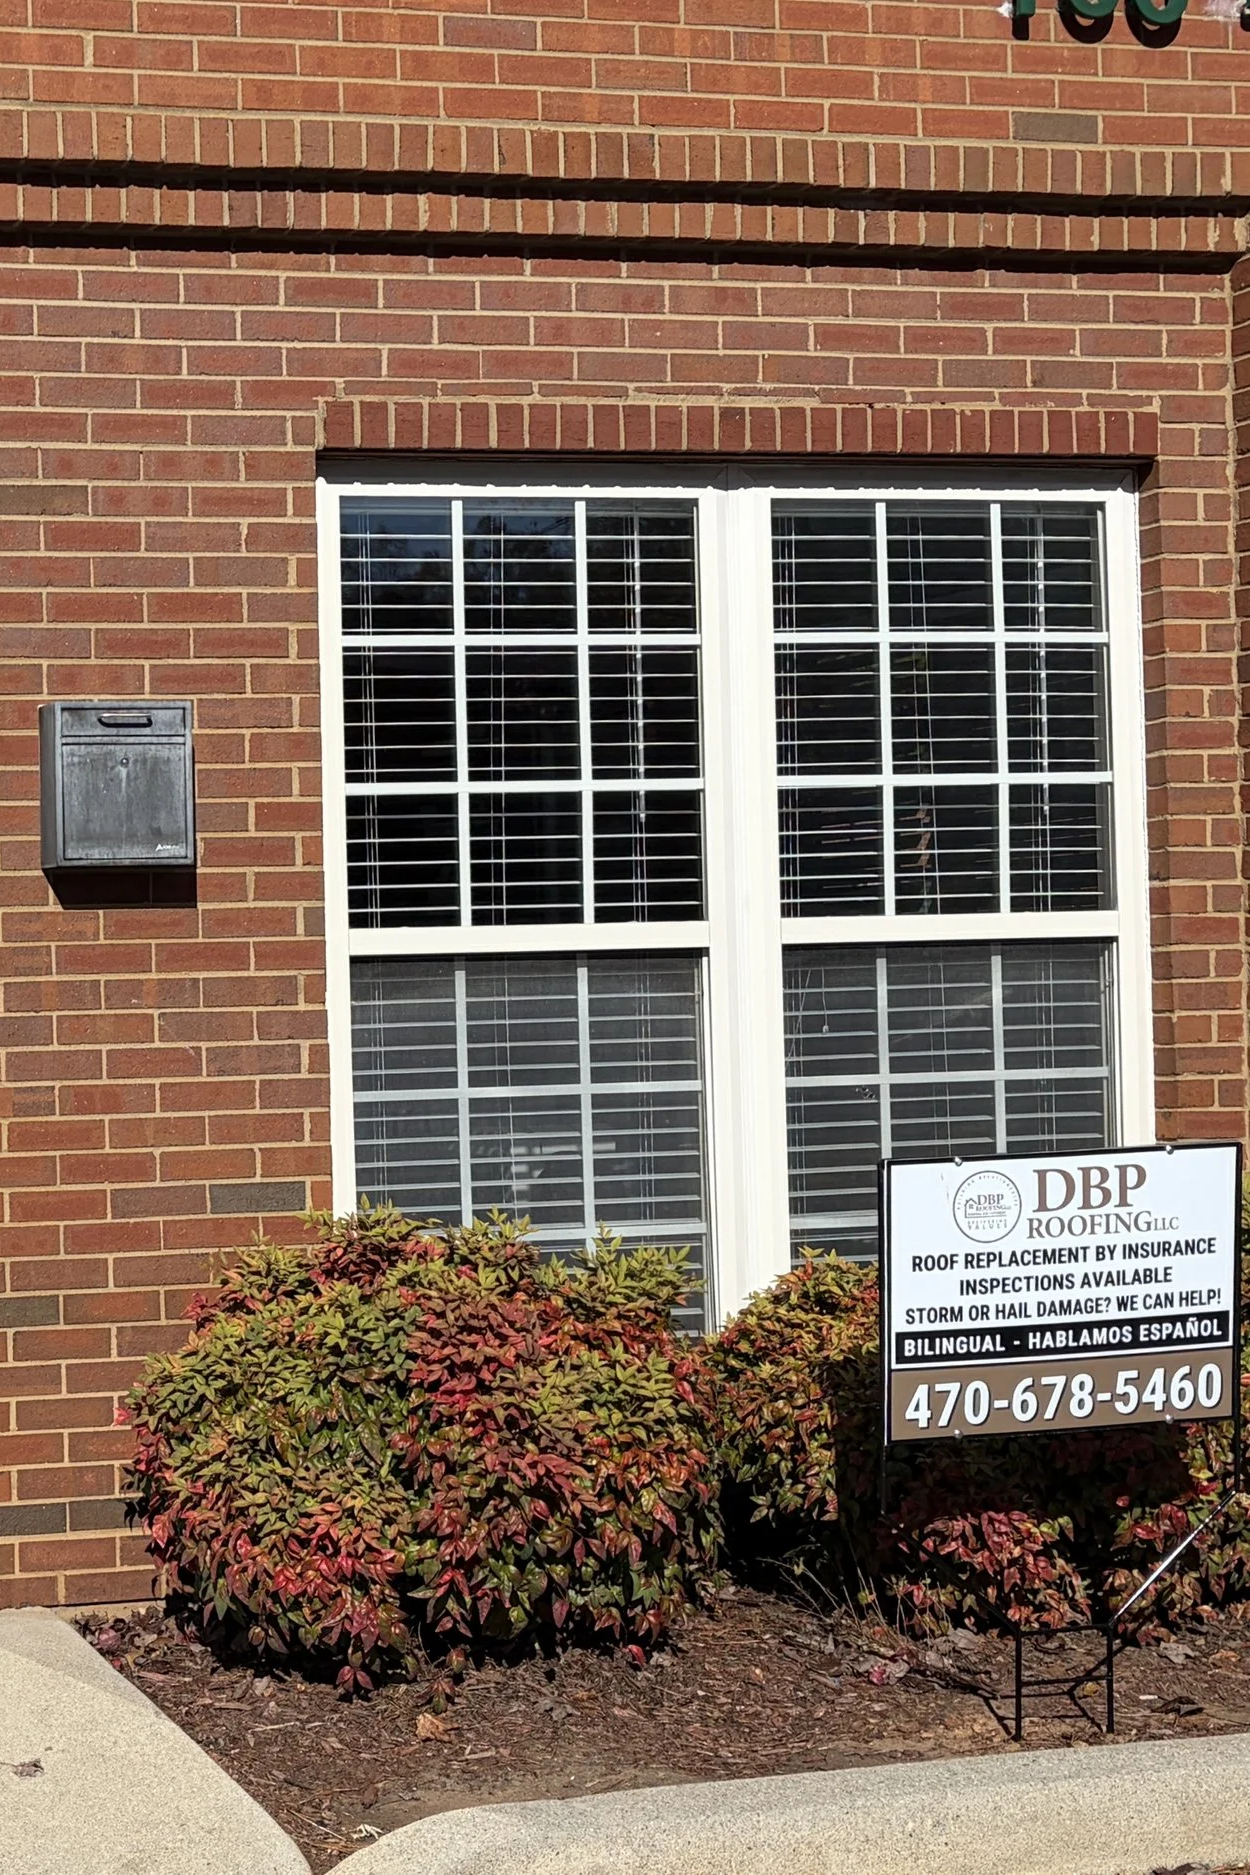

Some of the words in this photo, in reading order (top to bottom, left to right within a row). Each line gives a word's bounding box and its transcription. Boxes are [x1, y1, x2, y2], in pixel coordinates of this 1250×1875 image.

[977, 1194, 1004, 1205] DBP
[1032, 1163, 1148, 1213] DBP
[1026, 1211, 1153, 1240] ROOFING
[1152, 1216, 1180, 1232] LLC
[912, 1253, 959, 1272] ROOF
[964, 1246, 1091, 1270] REPLACEMENT
[1095, 1245, 1117, 1262] BY
[1122, 1237, 1217, 1260] INSURANCE
[959, 1273, 1076, 1296] INSPECTIONS
[1080, 1266, 1173, 1289] AVAILABLE
[905, 1303, 964, 1325] STORM
[968, 1304, 991, 1322] OR
[995, 1301, 1032, 1320] HAIL
[1037, 1296, 1112, 1318] DAMAGE?
[1116, 1295, 1139, 1312] WE
[1142, 1291, 1174, 1310] CAN
[1178, 1288, 1222, 1308] HELP!
[903, 1334, 1006, 1357] BILINGUAL
[1028, 1326, 1133, 1350] HABLAMOS
[1139, 1317, 1222, 1342] ESPAÑOL
[905, 1363, 1222, 1429] 470-678-5460
